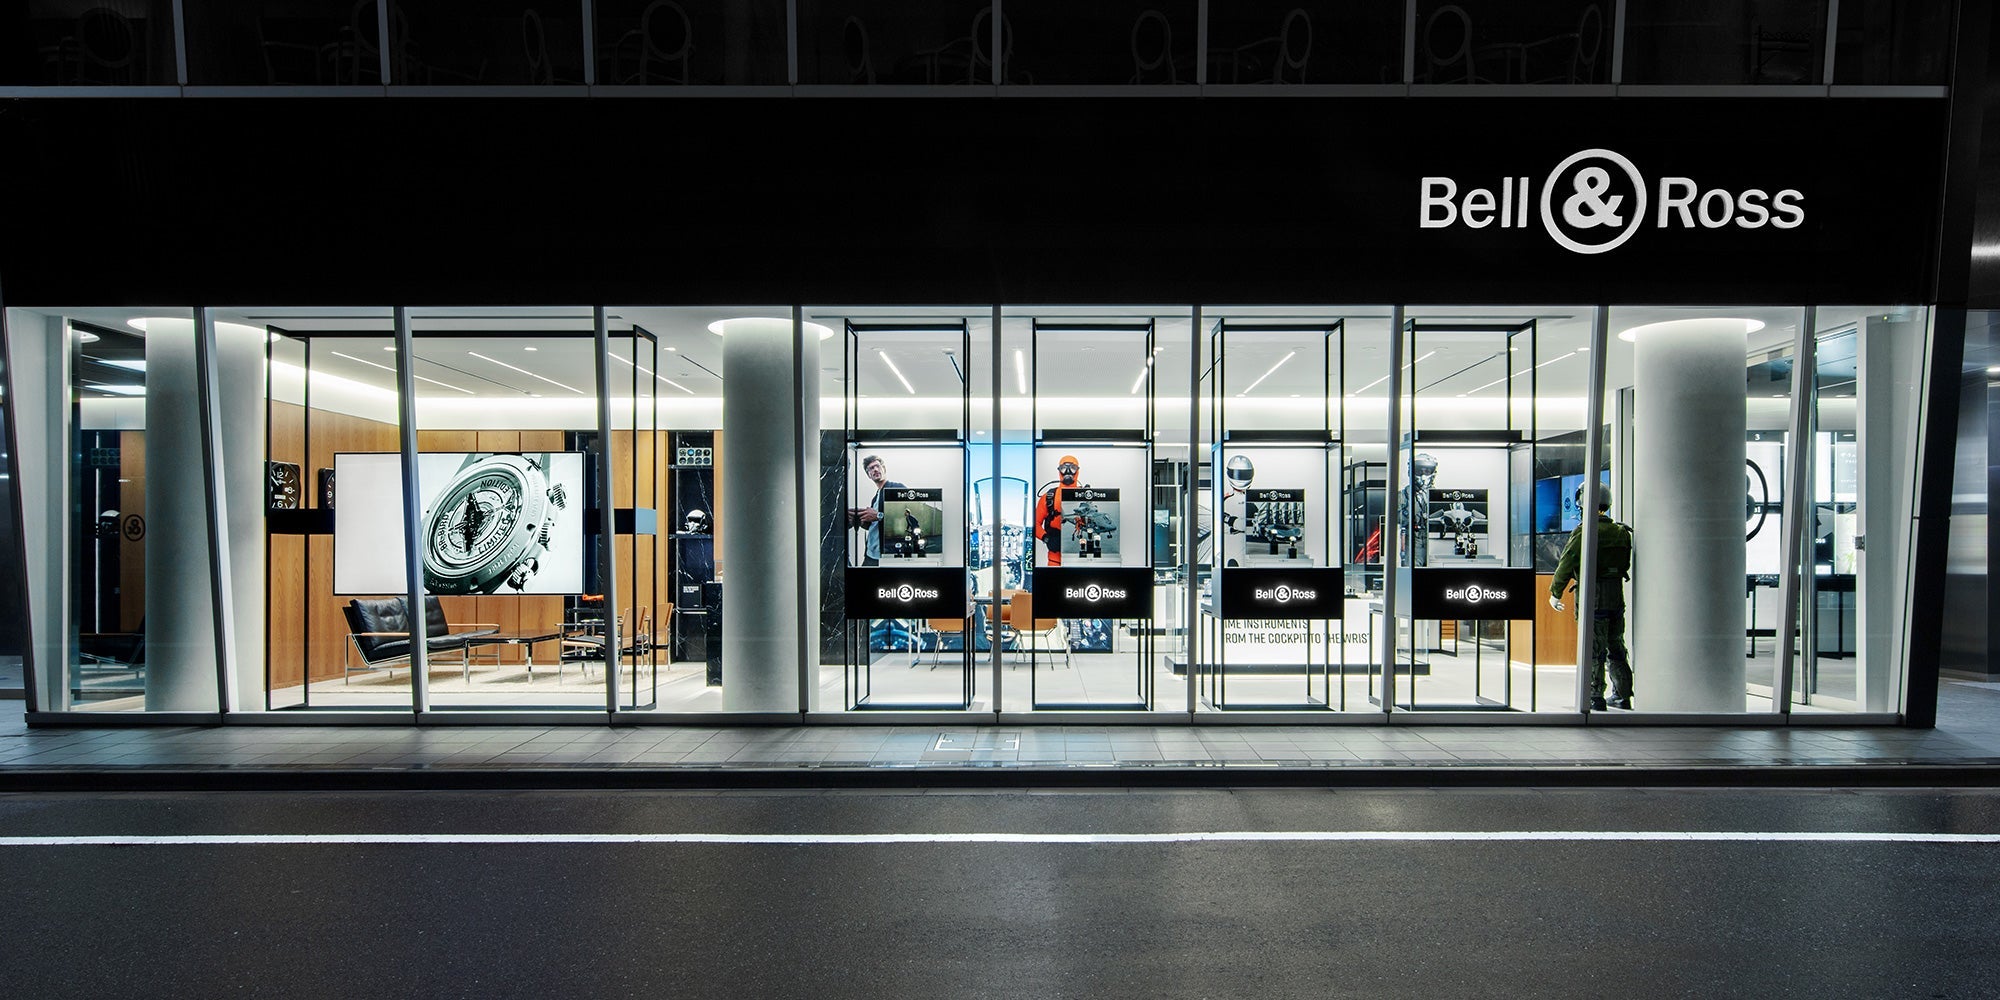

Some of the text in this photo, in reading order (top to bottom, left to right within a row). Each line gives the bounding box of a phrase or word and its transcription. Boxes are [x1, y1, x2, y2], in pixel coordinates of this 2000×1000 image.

[1419, 176, 1530, 229] Bell
[1657, 176, 1805, 229] Ross
[480, 480, 510, 494] EDITION
[478, 518, 511, 555] LIMITED
[878, 588, 896, 598] Bell
[914, 588, 938, 598] Ross
[1066, 588, 1084, 598] Bell
[1102, 588, 1126, 598] Ross
[1255, 589, 1273, 599] Bell
[1292, 589, 1315, 599] Ross
[1446, 589, 1464, 599] Bell
[1483, 589, 1506, 599] Ross
[1225, 619, 1241, 629] IME
[1225, 632, 1370, 644] ROM THE COCKPIT TO HE WRIS
